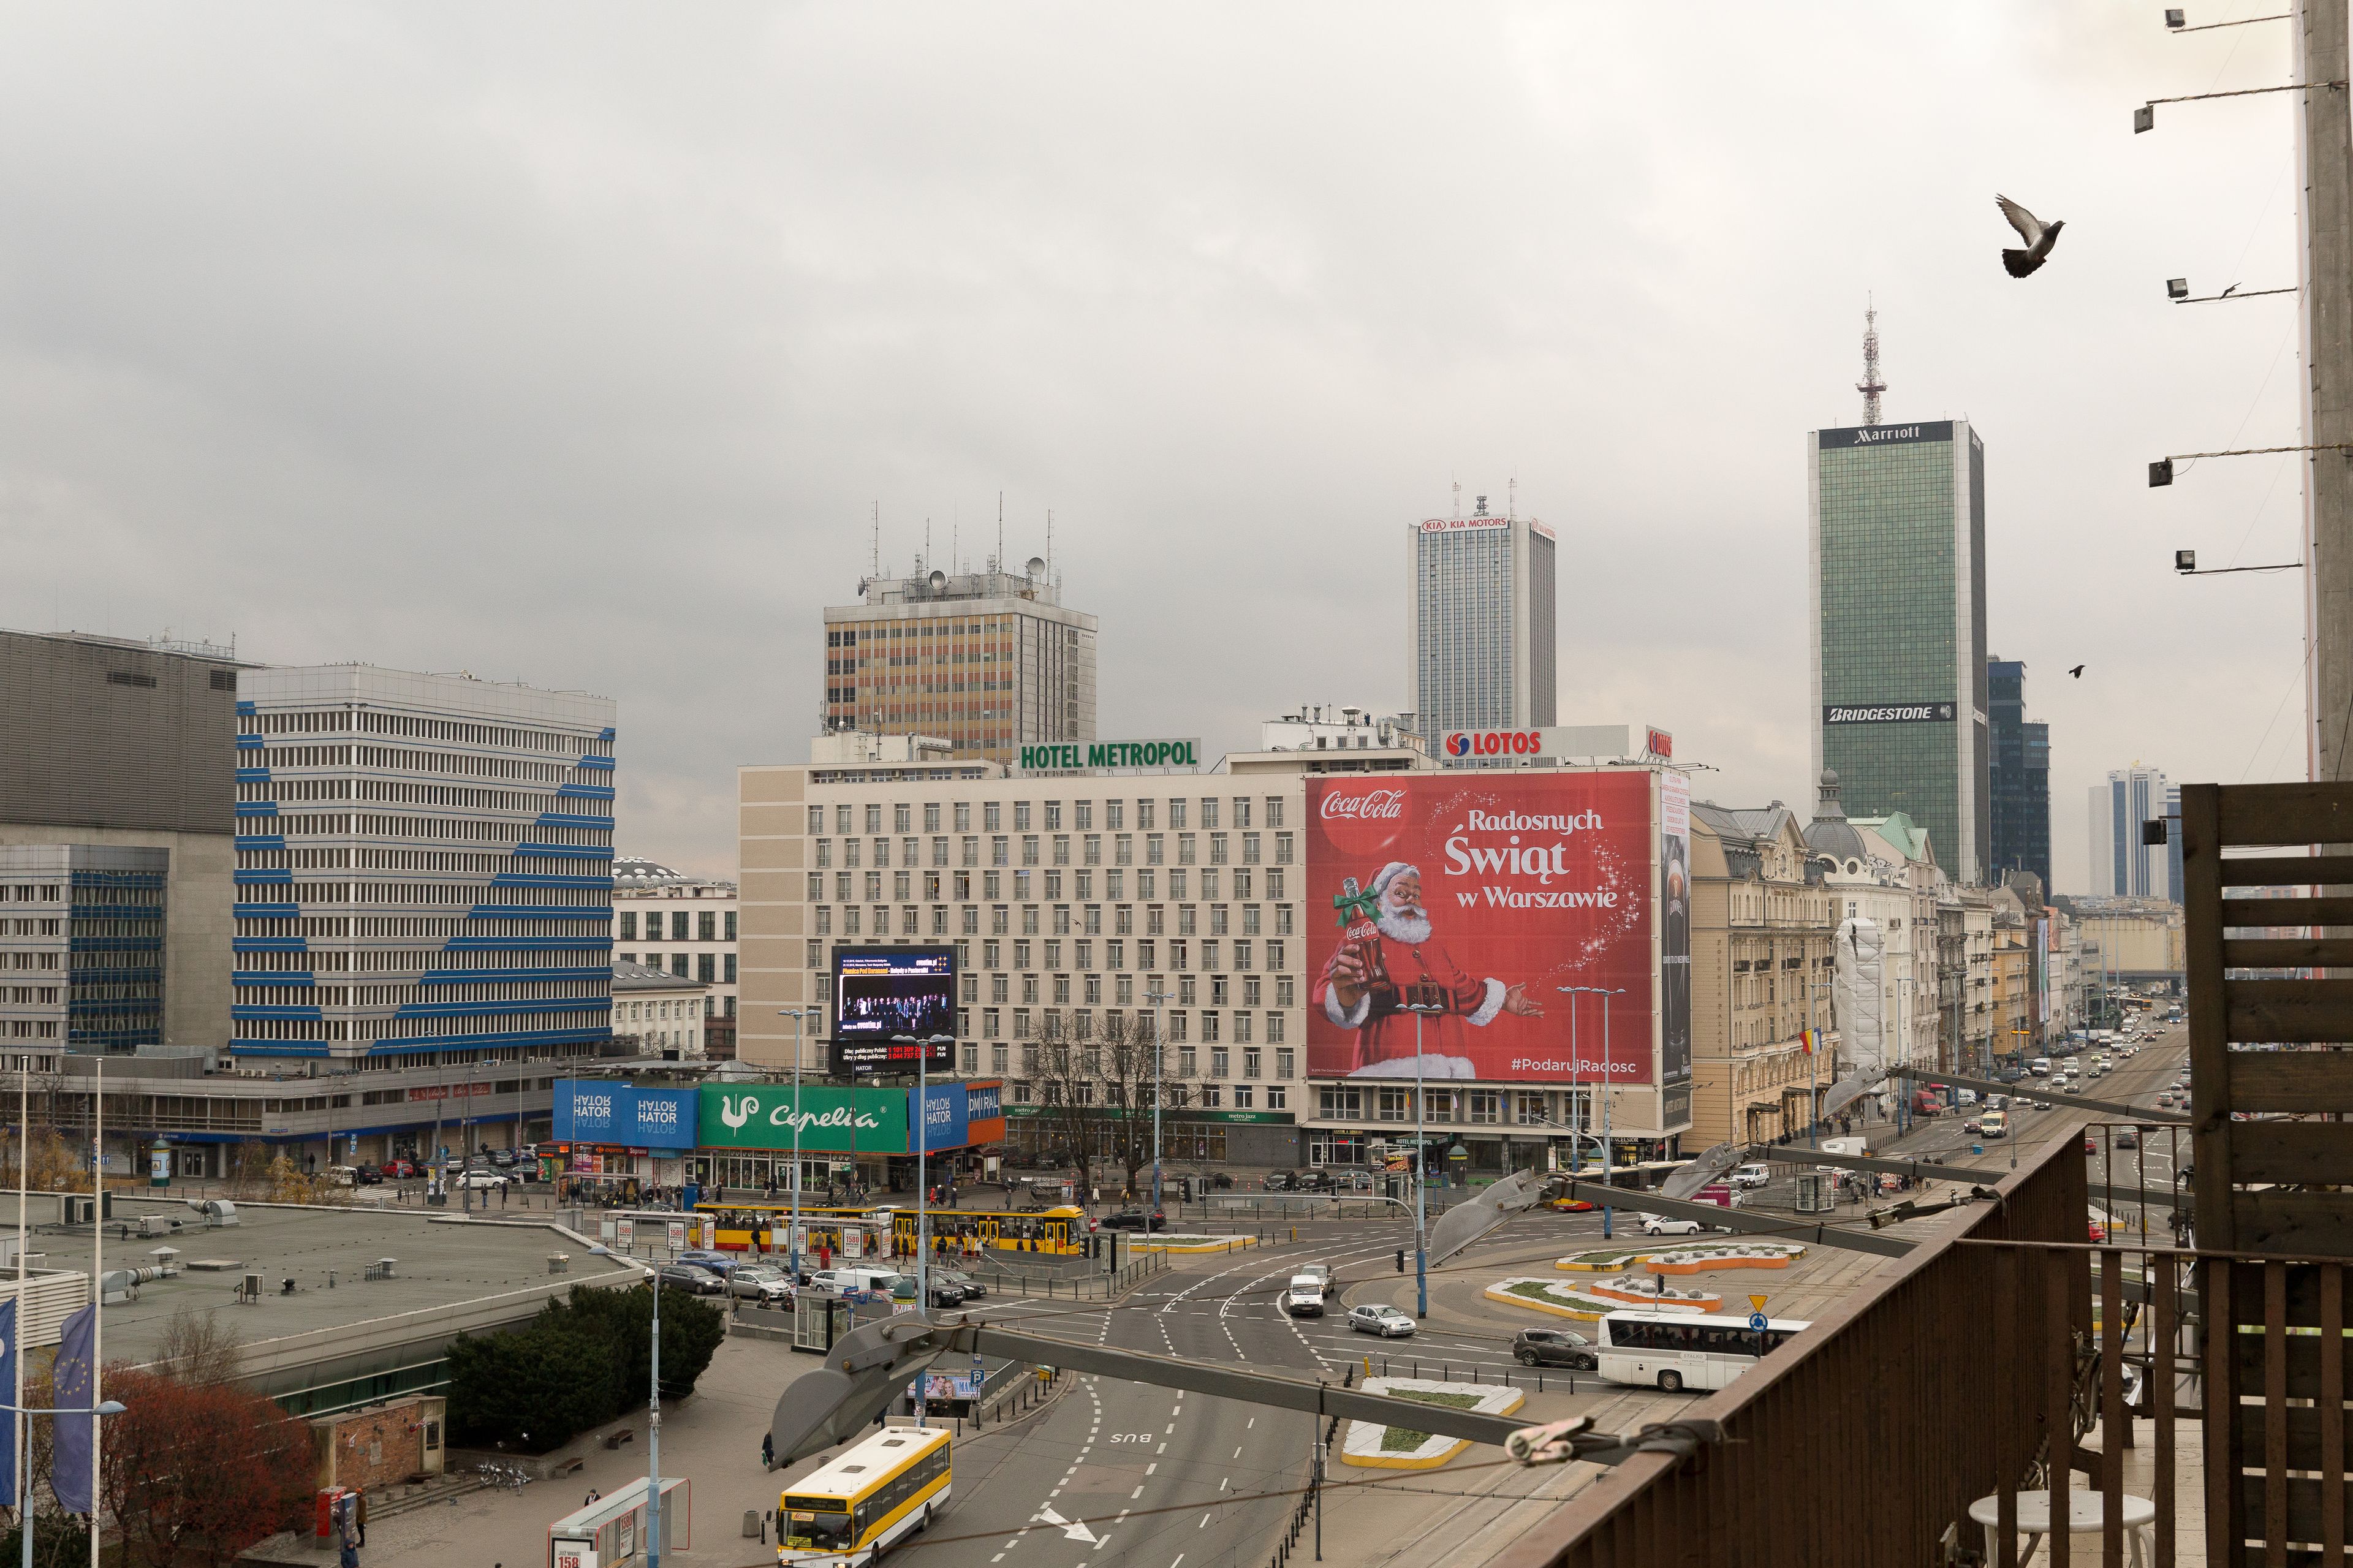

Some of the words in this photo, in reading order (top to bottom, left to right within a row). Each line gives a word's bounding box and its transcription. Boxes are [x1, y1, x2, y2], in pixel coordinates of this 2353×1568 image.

[1854, 426, 1920, 444] Marriott
[1469, 518, 1506, 527] MOTORS
[1828, 706, 1932, 722] BRIDGESTONE
[1474, 732, 1540, 755] LOTOS
[1656, 732, 1672, 757] LOTOS
[1021, 745, 1083, 768] HOTEL
[1088, 741, 1197, 767] METROPOL
[1321, 790, 1407, 819] Coca-Cola
[1468, 809, 1604, 836] Radosnych
[1444, 824, 1571, 884] Świąt
[1456, 893, 1479, 908] w
[1482, 886, 1618, 908] Warszawie
[1347, 922, 1376, 940] Coca-Cola
[857, 1020, 882, 1030] eventim.pl
[574, 1106, 611, 1117] HATOR
[969, 1096, 998, 1112] DMIRAL
[638, 1112, 676, 1123] HATOR
[770, 1105, 879, 1132] Cepelia
[927, 1110, 951, 1124] HATOR
[974, 1374, 982, 1383] P
[1110, 1434, 1152, 1443] BUS
[621, 1514, 632, 1530] 1580
[558, 1556, 579, 1568] 158
